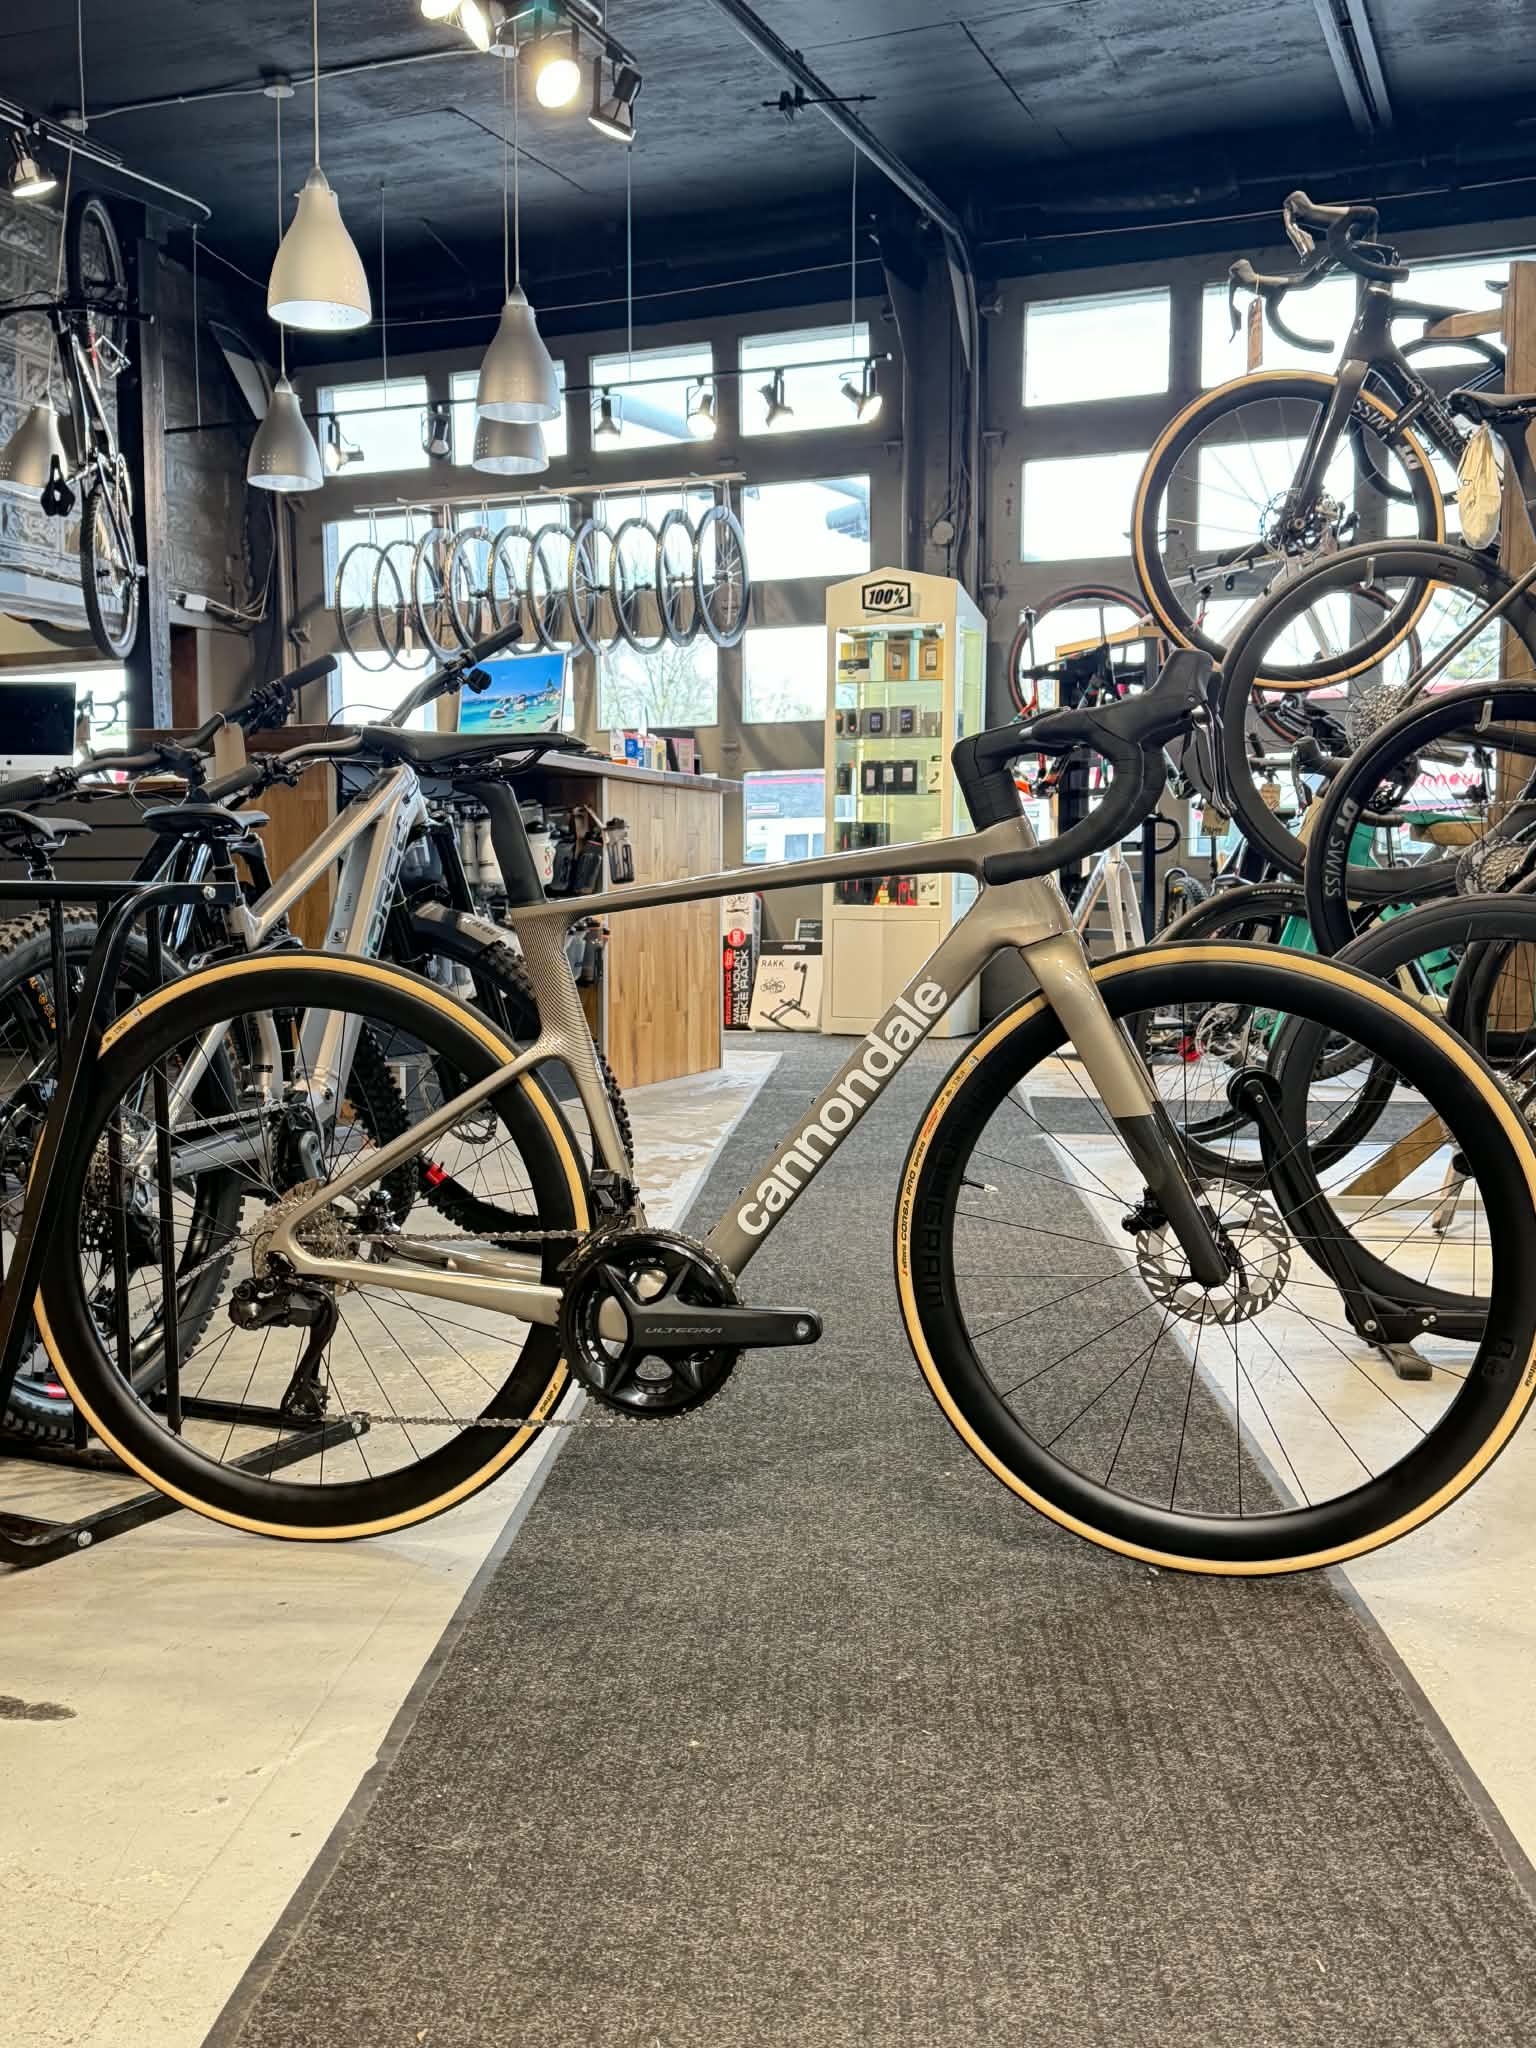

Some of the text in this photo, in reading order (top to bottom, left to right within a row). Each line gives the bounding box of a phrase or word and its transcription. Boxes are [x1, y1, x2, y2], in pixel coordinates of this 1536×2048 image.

[868, 588, 905, 606] 100%
[1324, 797, 1360, 897] DT SWISS
[733, 949, 741, 992] MOUNT
[760, 959, 785, 968] RAKK
[740, 949, 749, 1025] BIKE RACK
[733, 993, 741, 1025] WALL
[737, 981, 948, 1237] cannondale
[905, 1170, 917, 1196] PRO
[900, 1199, 911, 1242] CORSA
